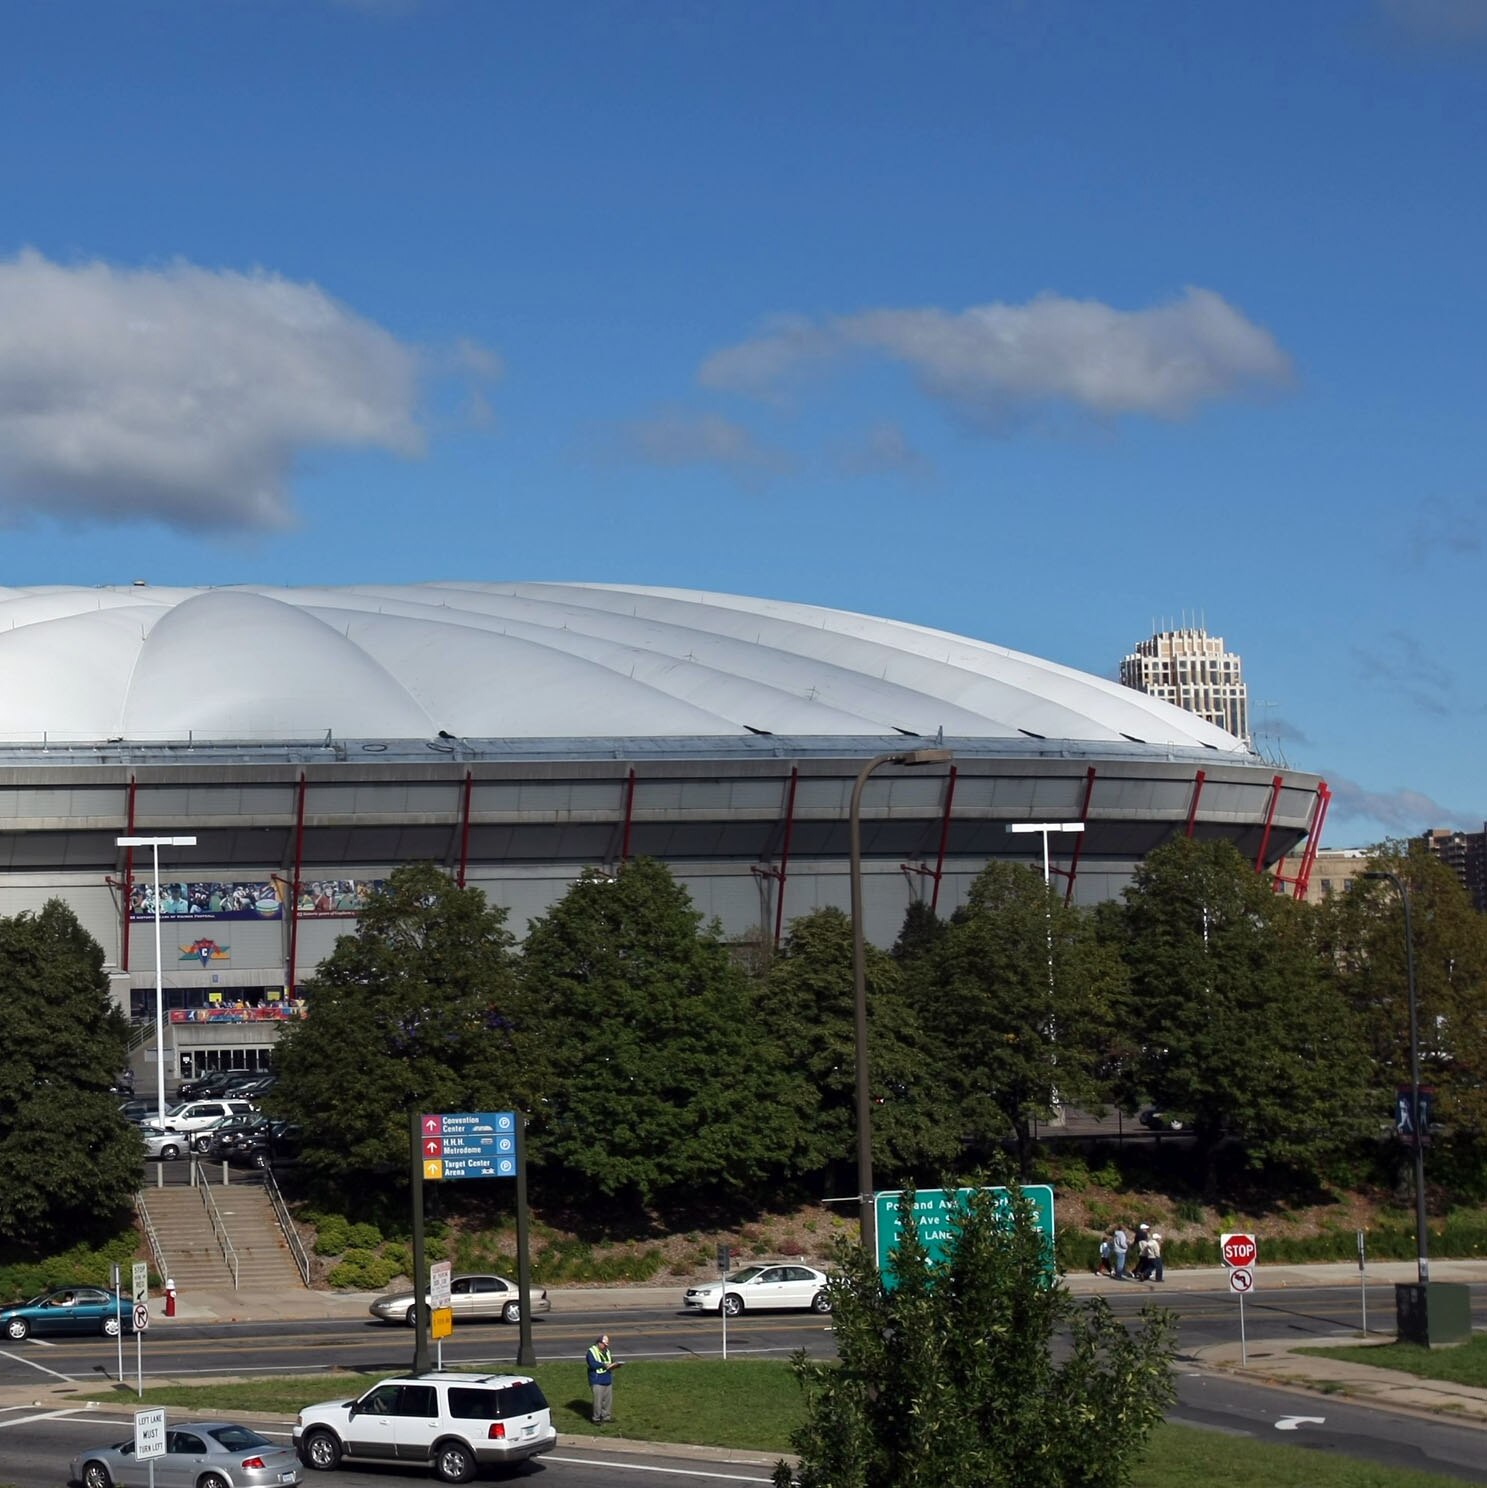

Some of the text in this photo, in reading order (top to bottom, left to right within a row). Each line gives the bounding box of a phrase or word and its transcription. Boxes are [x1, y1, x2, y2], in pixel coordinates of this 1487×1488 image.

[201, 948, 208, 957] C
[442, 1116, 480, 1124] Convention
[442, 1125, 465, 1133] Center
[443, 1147, 482, 1155] Metrodome
[444, 1160, 466, 1169] Target
[468, 1159, 491, 1167] Center
[886, 1200, 933, 1211] Poand
[919, 1215, 940, 1225] Ave
[1225, 1244, 1254, 1258] STOP
[139, 1414, 162, 1425] LEFT LANE
[143, 1428, 158, 1439] MUST
[139, 1442, 163, 1454] TURN LEFT
